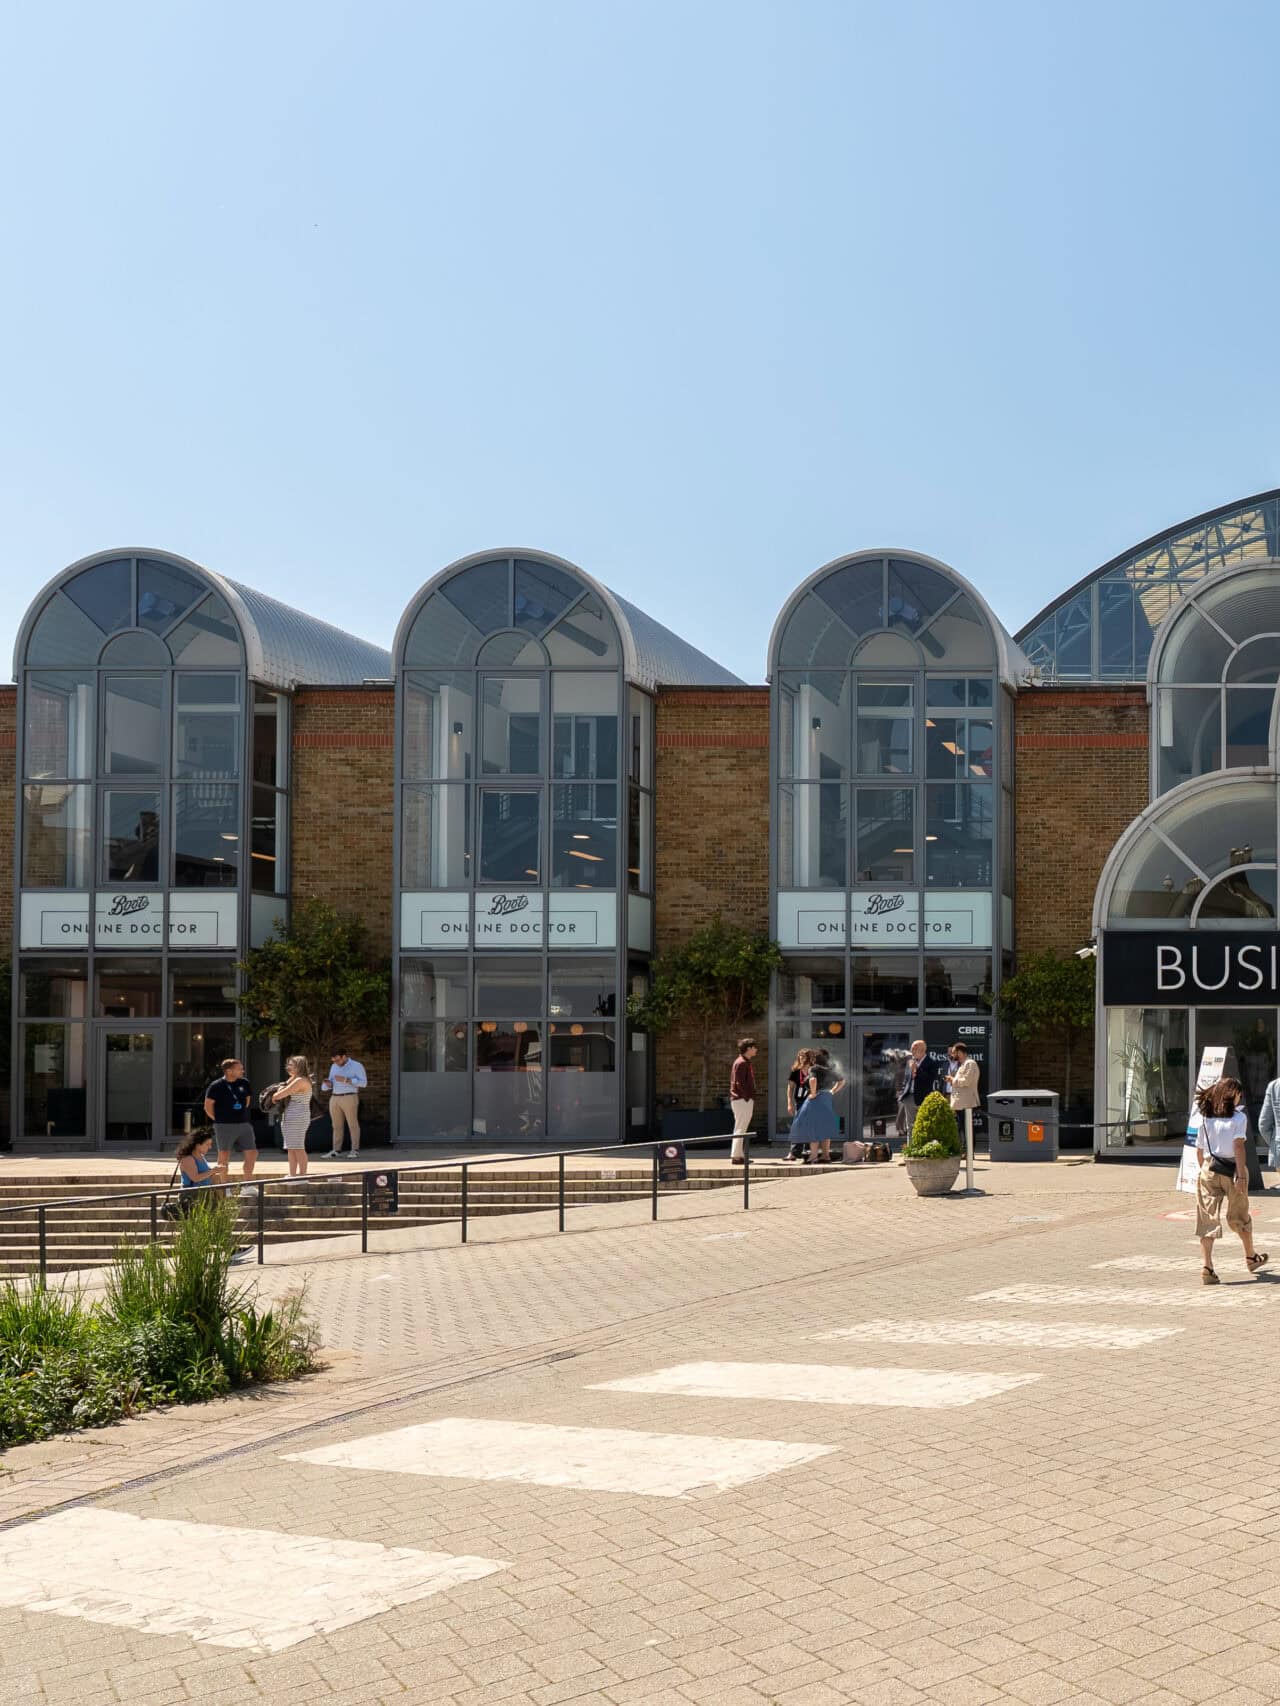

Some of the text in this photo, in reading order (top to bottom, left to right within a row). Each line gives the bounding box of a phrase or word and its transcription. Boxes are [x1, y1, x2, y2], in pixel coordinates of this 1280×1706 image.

[108, 895, 149, 916] Boots
[487, 894, 529, 916] Boots
[863, 894, 905, 916] Boots
[60, 923, 198, 934] ONLINE DOCTOR
[440, 923, 577, 933] ONLINE DOCTOR
[817, 922, 952, 933] ONLINE DOCTOR
[958, 1026, 986, 1035] CBRE
